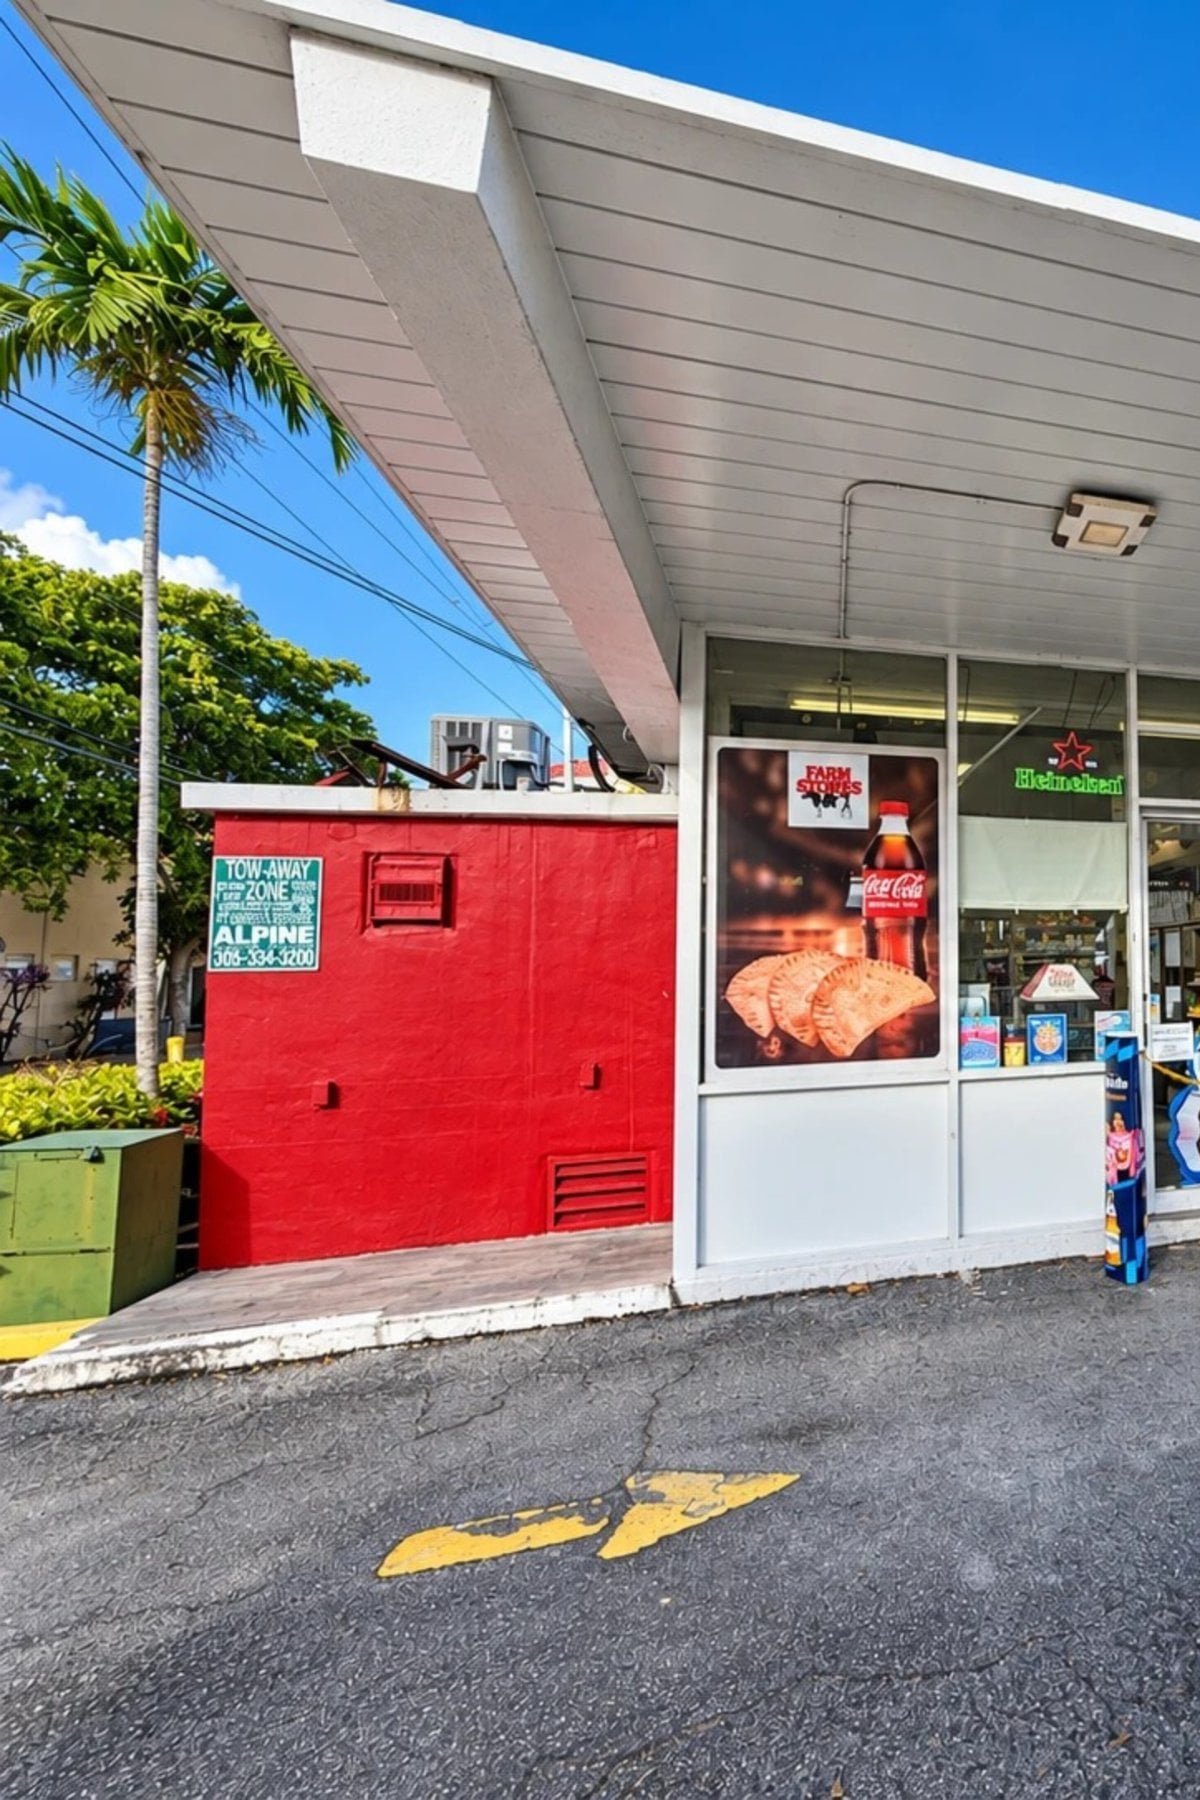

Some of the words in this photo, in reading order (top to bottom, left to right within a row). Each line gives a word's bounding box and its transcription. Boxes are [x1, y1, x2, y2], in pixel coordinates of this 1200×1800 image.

[806, 765, 852, 781] FARM
[225, 859, 311, 880] TOW-AWAY
[245, 880, 289, 901] ZONE
[214, 925, 314, 945] ALPINE
